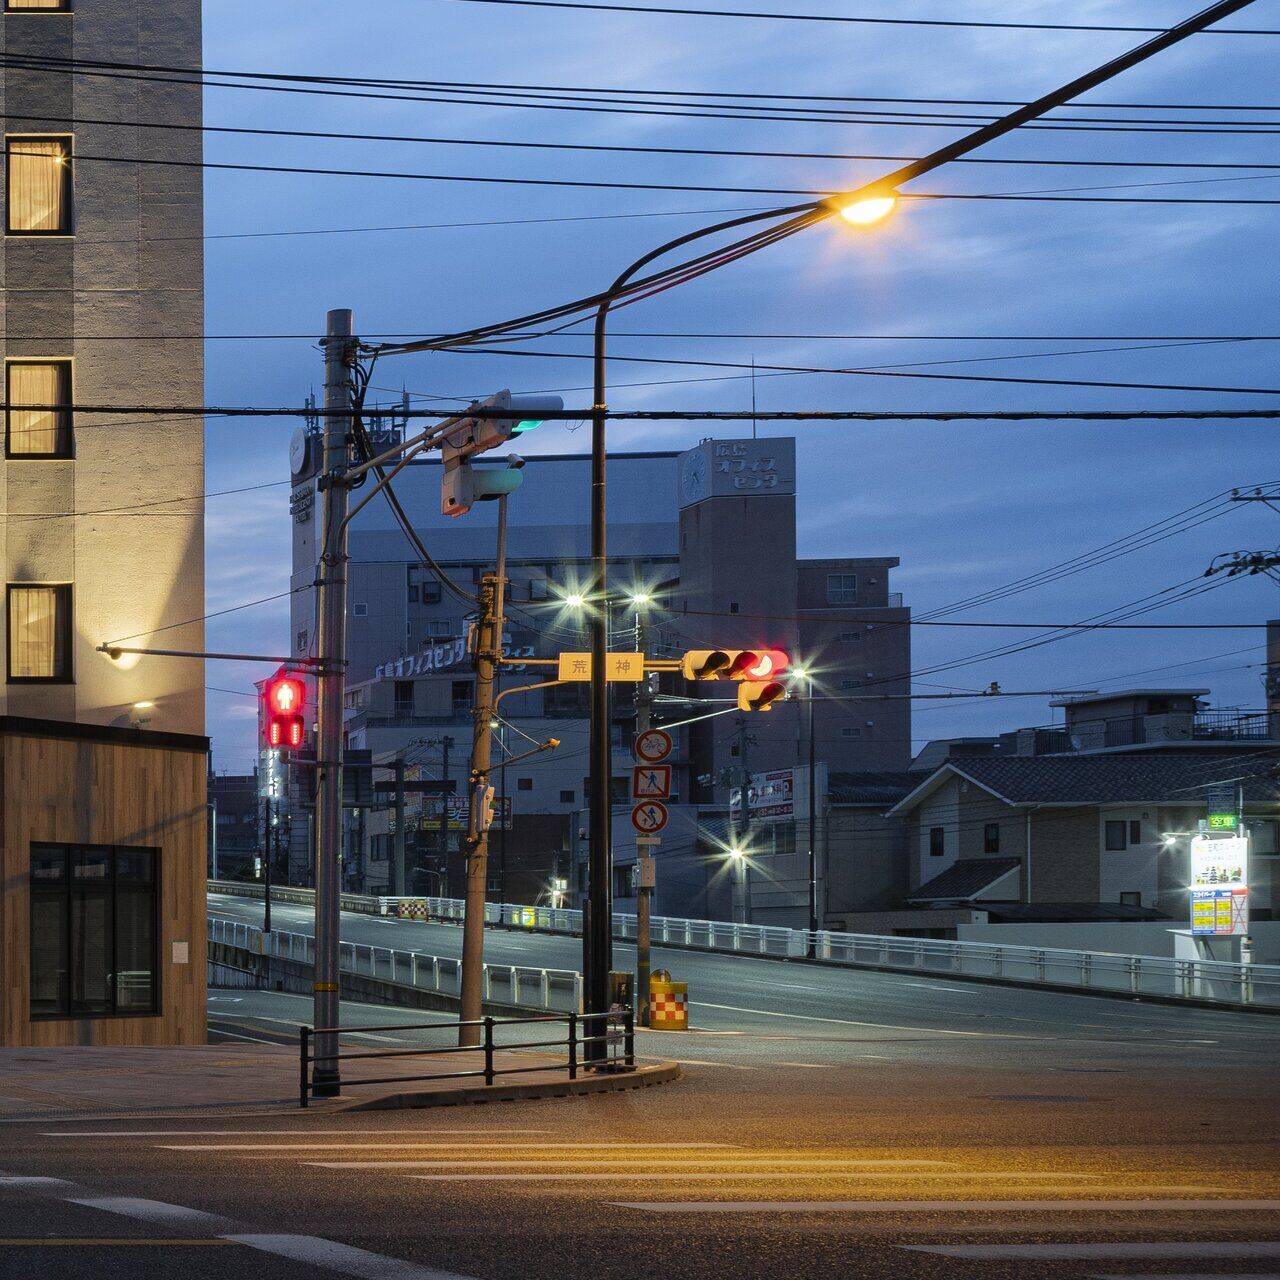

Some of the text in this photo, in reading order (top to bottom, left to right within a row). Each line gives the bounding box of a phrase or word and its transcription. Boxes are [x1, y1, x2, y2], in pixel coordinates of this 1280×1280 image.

[715, 459, 777, 473] オフィス
[734, 476, 793, 489] センター
[572, 659, 631, 675] 荒神
